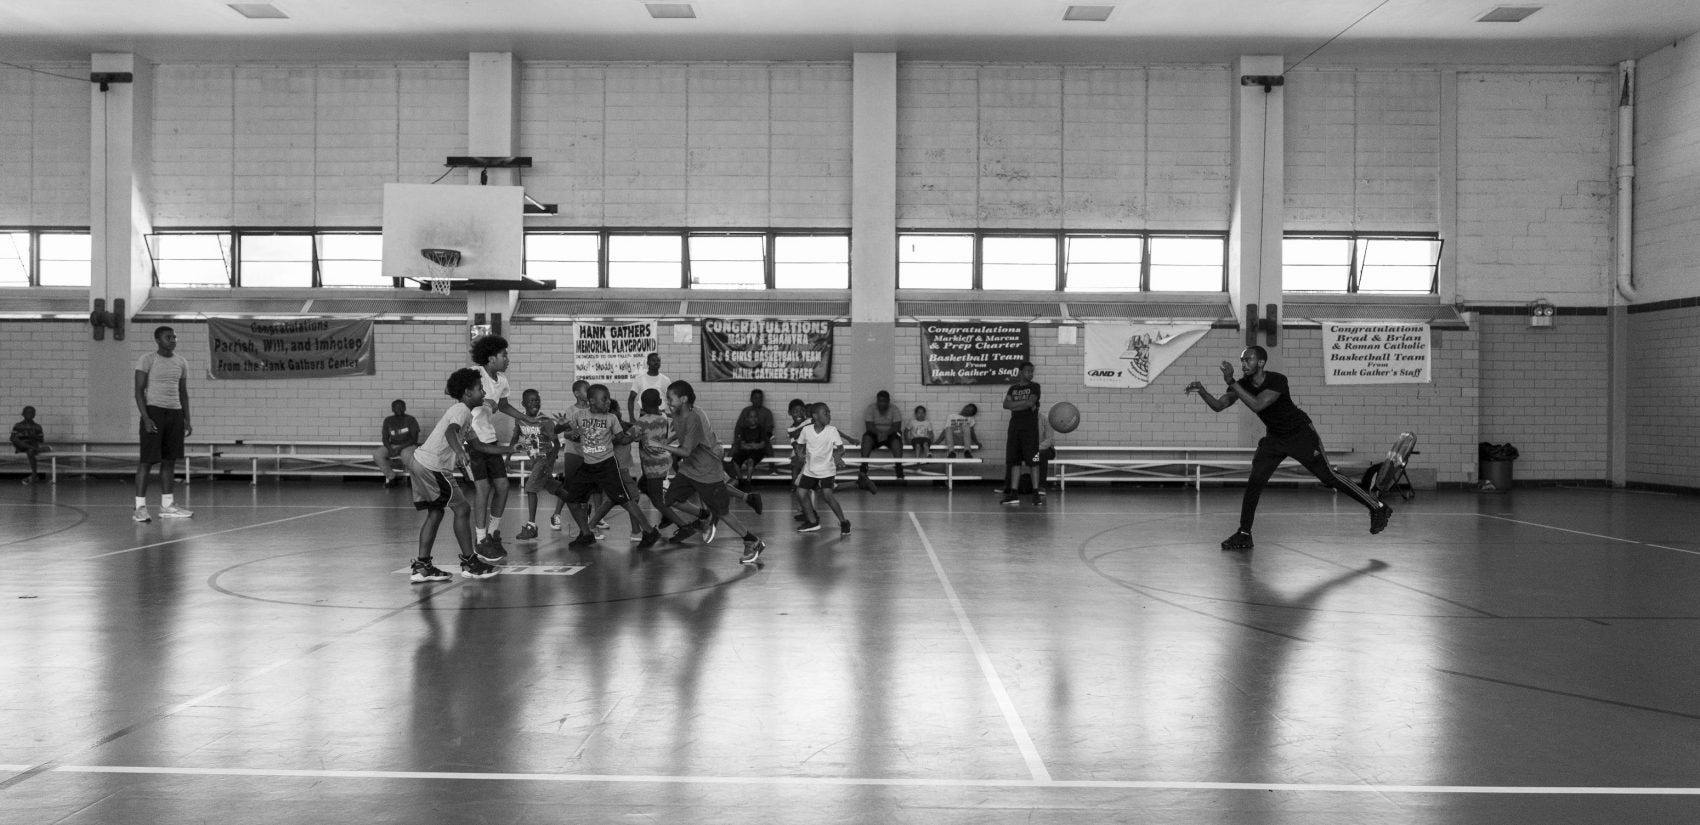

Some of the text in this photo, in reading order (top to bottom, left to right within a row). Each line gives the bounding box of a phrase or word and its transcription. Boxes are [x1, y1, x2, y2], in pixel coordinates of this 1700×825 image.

[251, 320, 328, 335] Congratulations
[579, 323, 651, 339] HANK GATHERS
[705, 320, 828, 334] CONGRATULATIONS
[928, 325, 1021, 334] Congratulations
[1330, 325, 1424, 334] Congratulations
[727, 333, 757, 345] MARTY
[934, 335, 975, 343] Markieff
[1337, 334, 1421, 342] Brad & Brian
[214, 337, 362, 354] Parrish, Will, and Imhotep
[576, 338, 656, 353] MEMORIAL PLAYGROUND
[929, 342, 1023, 350] & Prep Charter
[1344, 342, 1380, 350] Roman
[1383, 342, 1426, 350] Catholic
[731, 350, 752, 362] GIRLS
[754, 350, 799, 362] BASKETBALL
[801, 350, 822, 362] TEAM
[929, 353, 1024, 362] Basketball Team
[1330, 353, 1425, 361] Basketball Team
[218, 357, 359, 372] From the Hank Gathers Center
[732, 368, 813, 379] HANK GATHERS STAFF
[932, 367, 1019, 377] Hank Gather's Staff
[1360, 368, 1397, 377] Gather's
[1399, 368, 1423, 378] Staff
